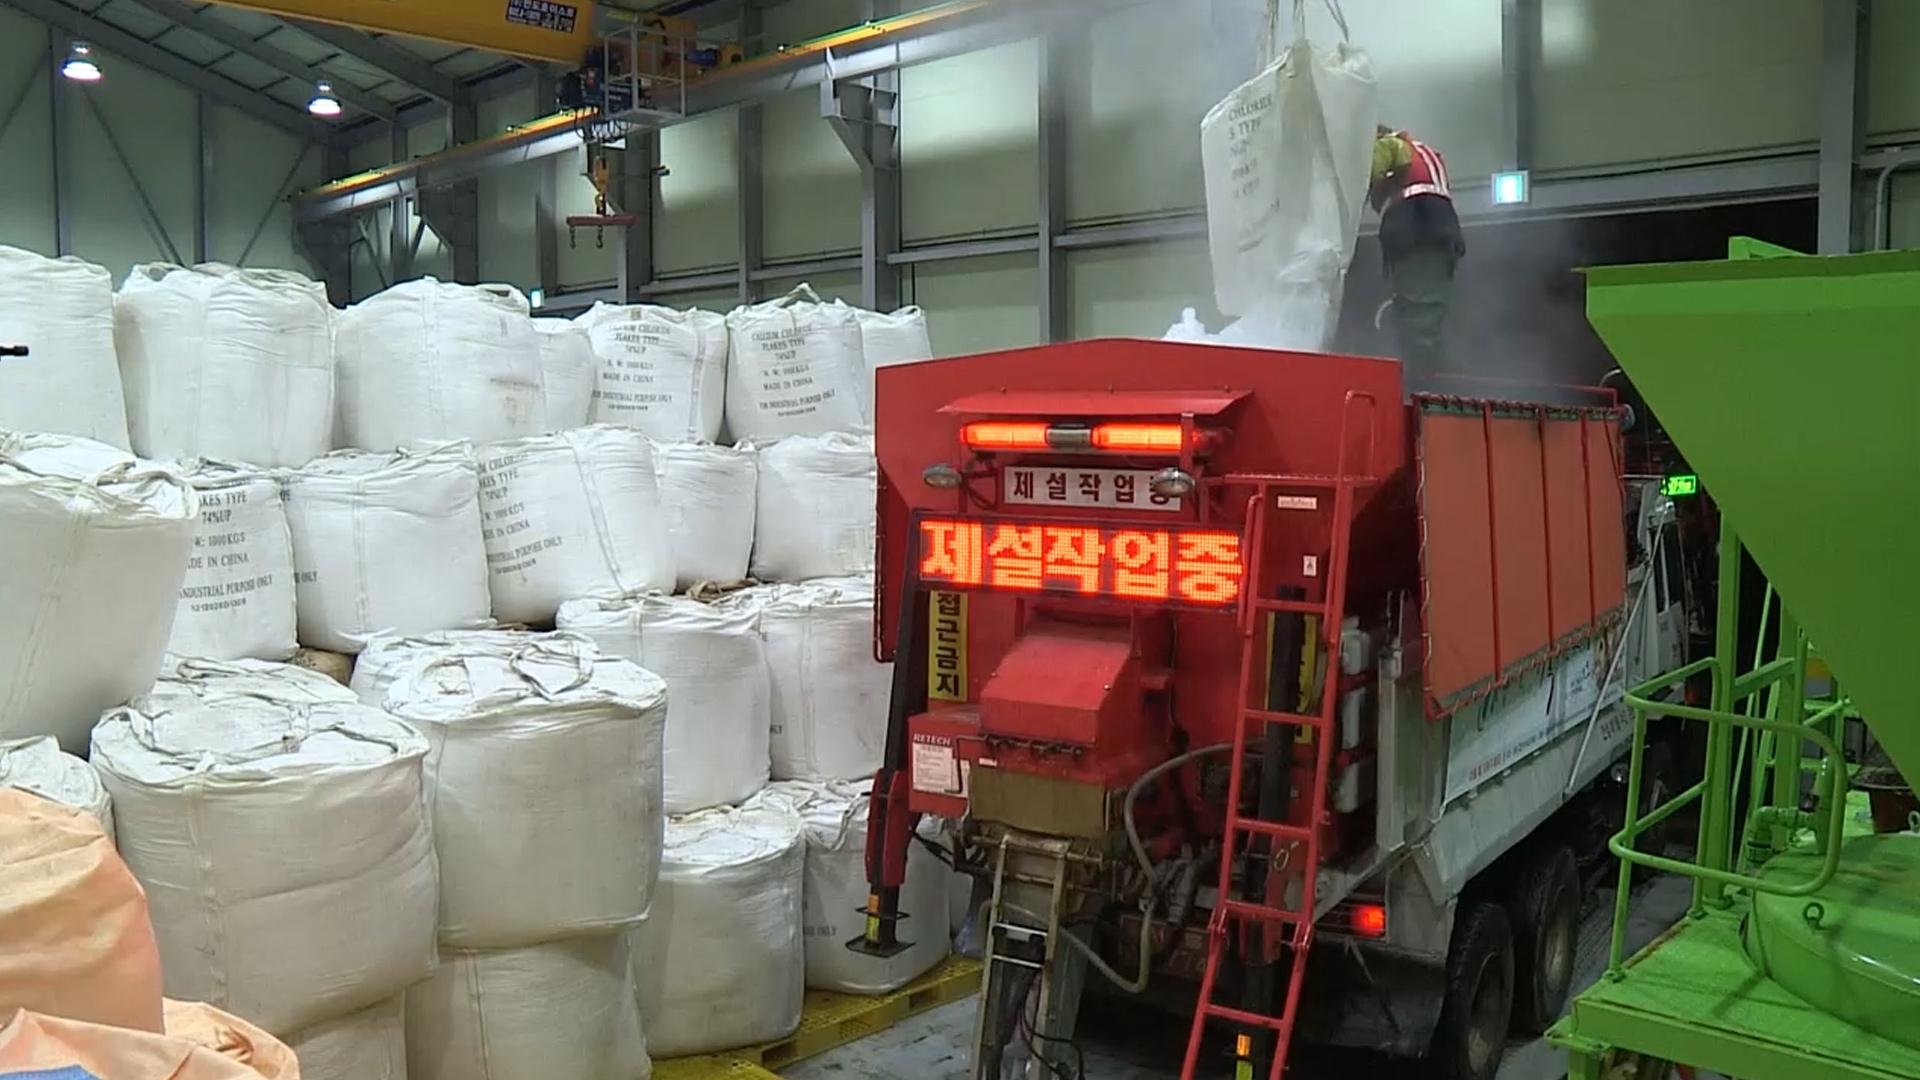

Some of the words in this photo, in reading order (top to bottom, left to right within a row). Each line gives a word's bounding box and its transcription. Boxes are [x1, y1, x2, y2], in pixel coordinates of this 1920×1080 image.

[225, 490, 247, 505] TYPE
[187, 557, 203, 570] DE
[207, 555, 218, 568] IN
[220, 551, 249, 567] CHINA
[919, 520, 1243, 603] 제설작업중
[226, 578, 255, 597] PURPOSE
[256, 573, 273, 589] ONLY
[935, 592, 961, 698] 접근금지
[913, 732, 952, 747] RETECH
